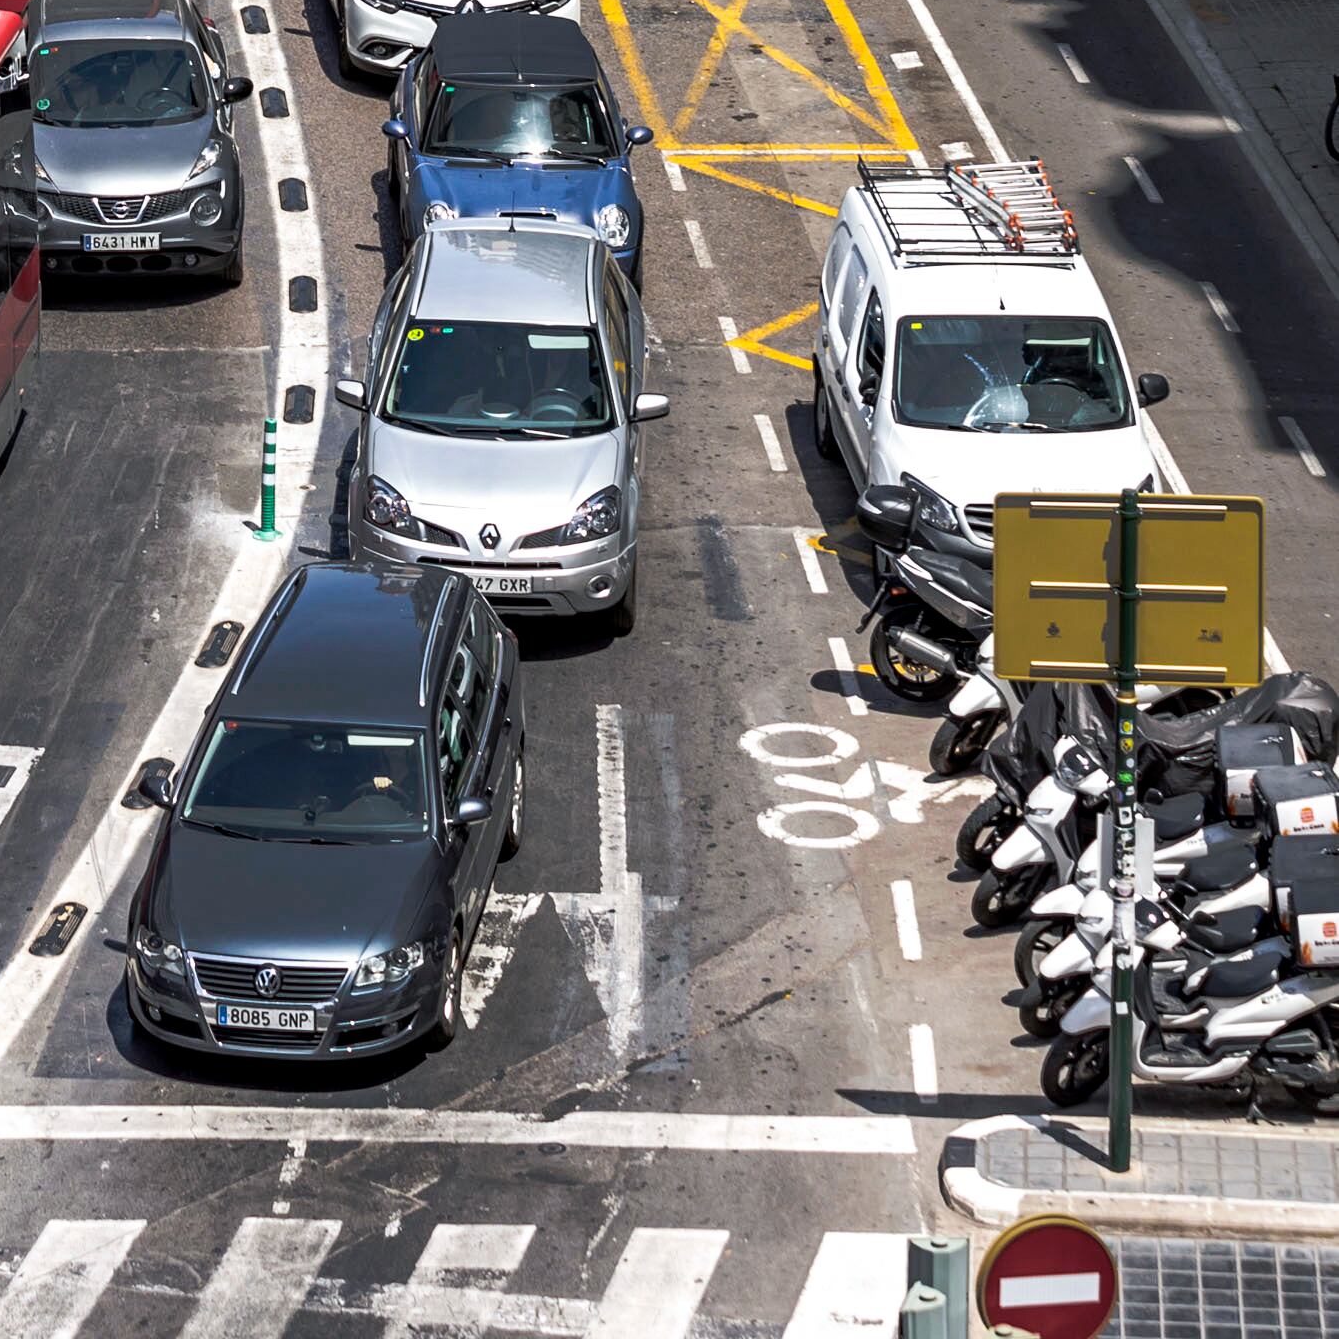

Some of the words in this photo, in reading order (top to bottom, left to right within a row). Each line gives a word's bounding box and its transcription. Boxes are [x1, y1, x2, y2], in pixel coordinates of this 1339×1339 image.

[93, 236, 125, 249] 6431
[130, 236, 156, 248] HWY
[499, 578, 528, 592] GXR
[230, 1008, 271, 1027] 8085
[278, 1012, 309, 1028] GNP
